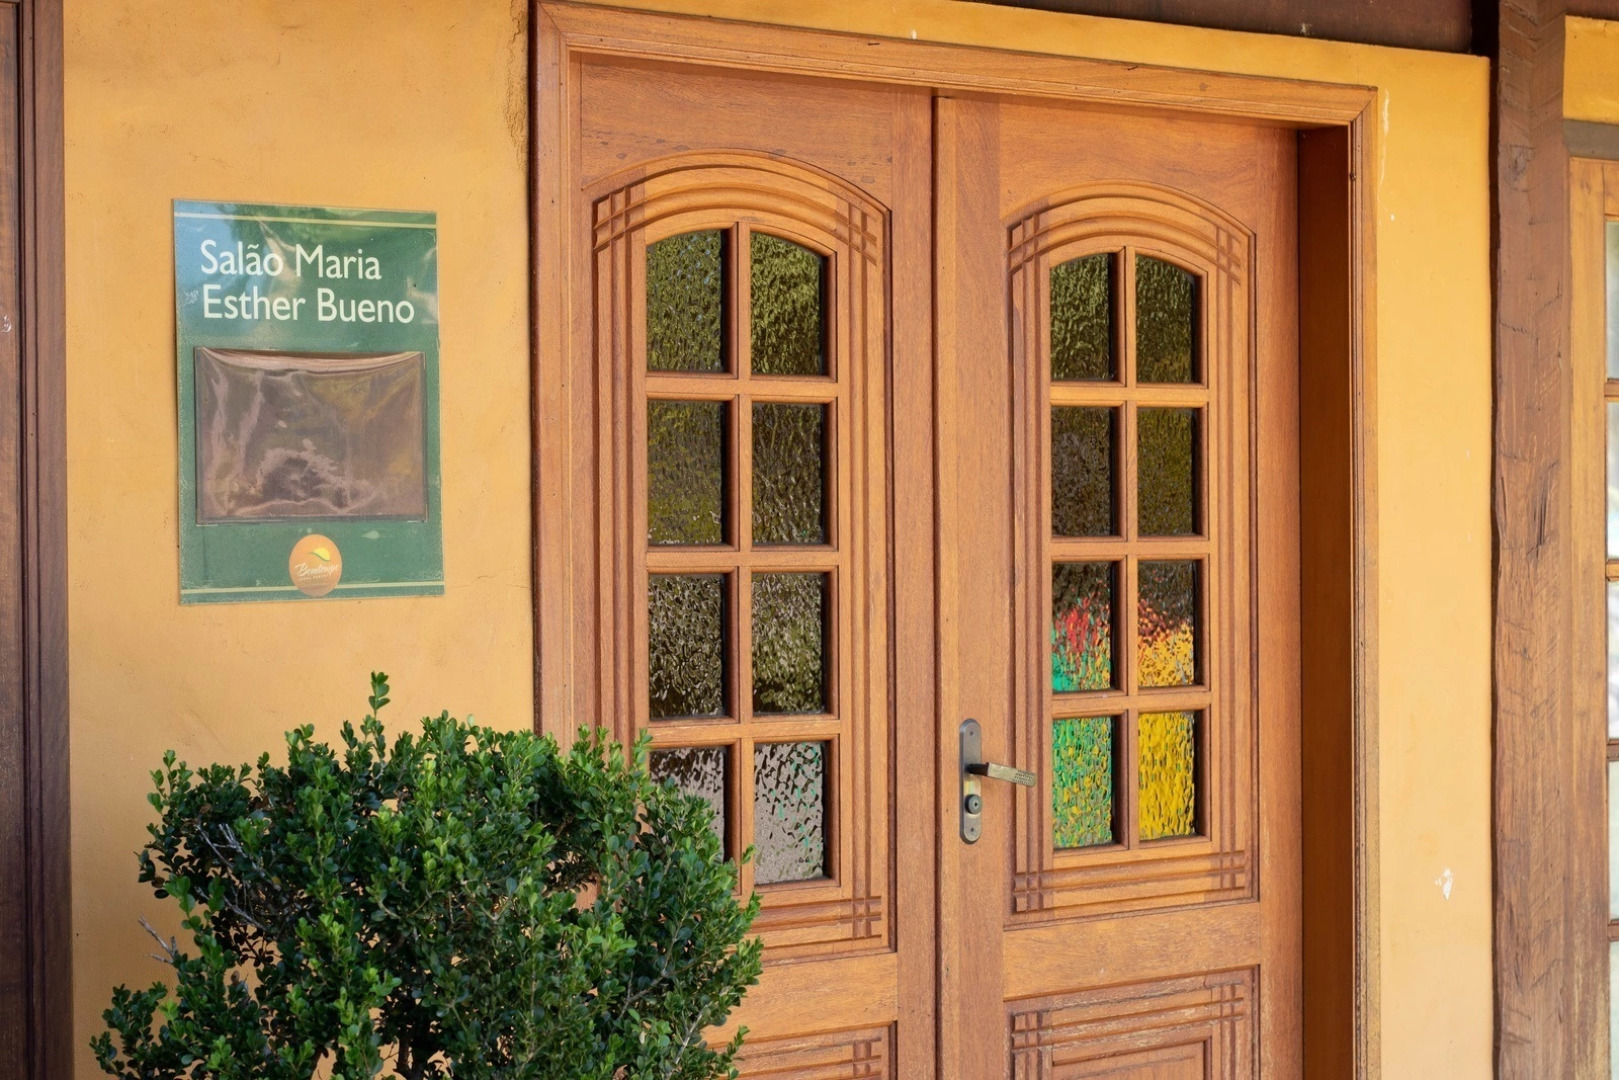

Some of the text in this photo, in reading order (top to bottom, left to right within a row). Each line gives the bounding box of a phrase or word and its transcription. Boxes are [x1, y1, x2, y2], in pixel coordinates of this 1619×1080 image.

[200, 239, 382, 280] Salão Maria
[203, 284, 415, 323] Esther Bueno
